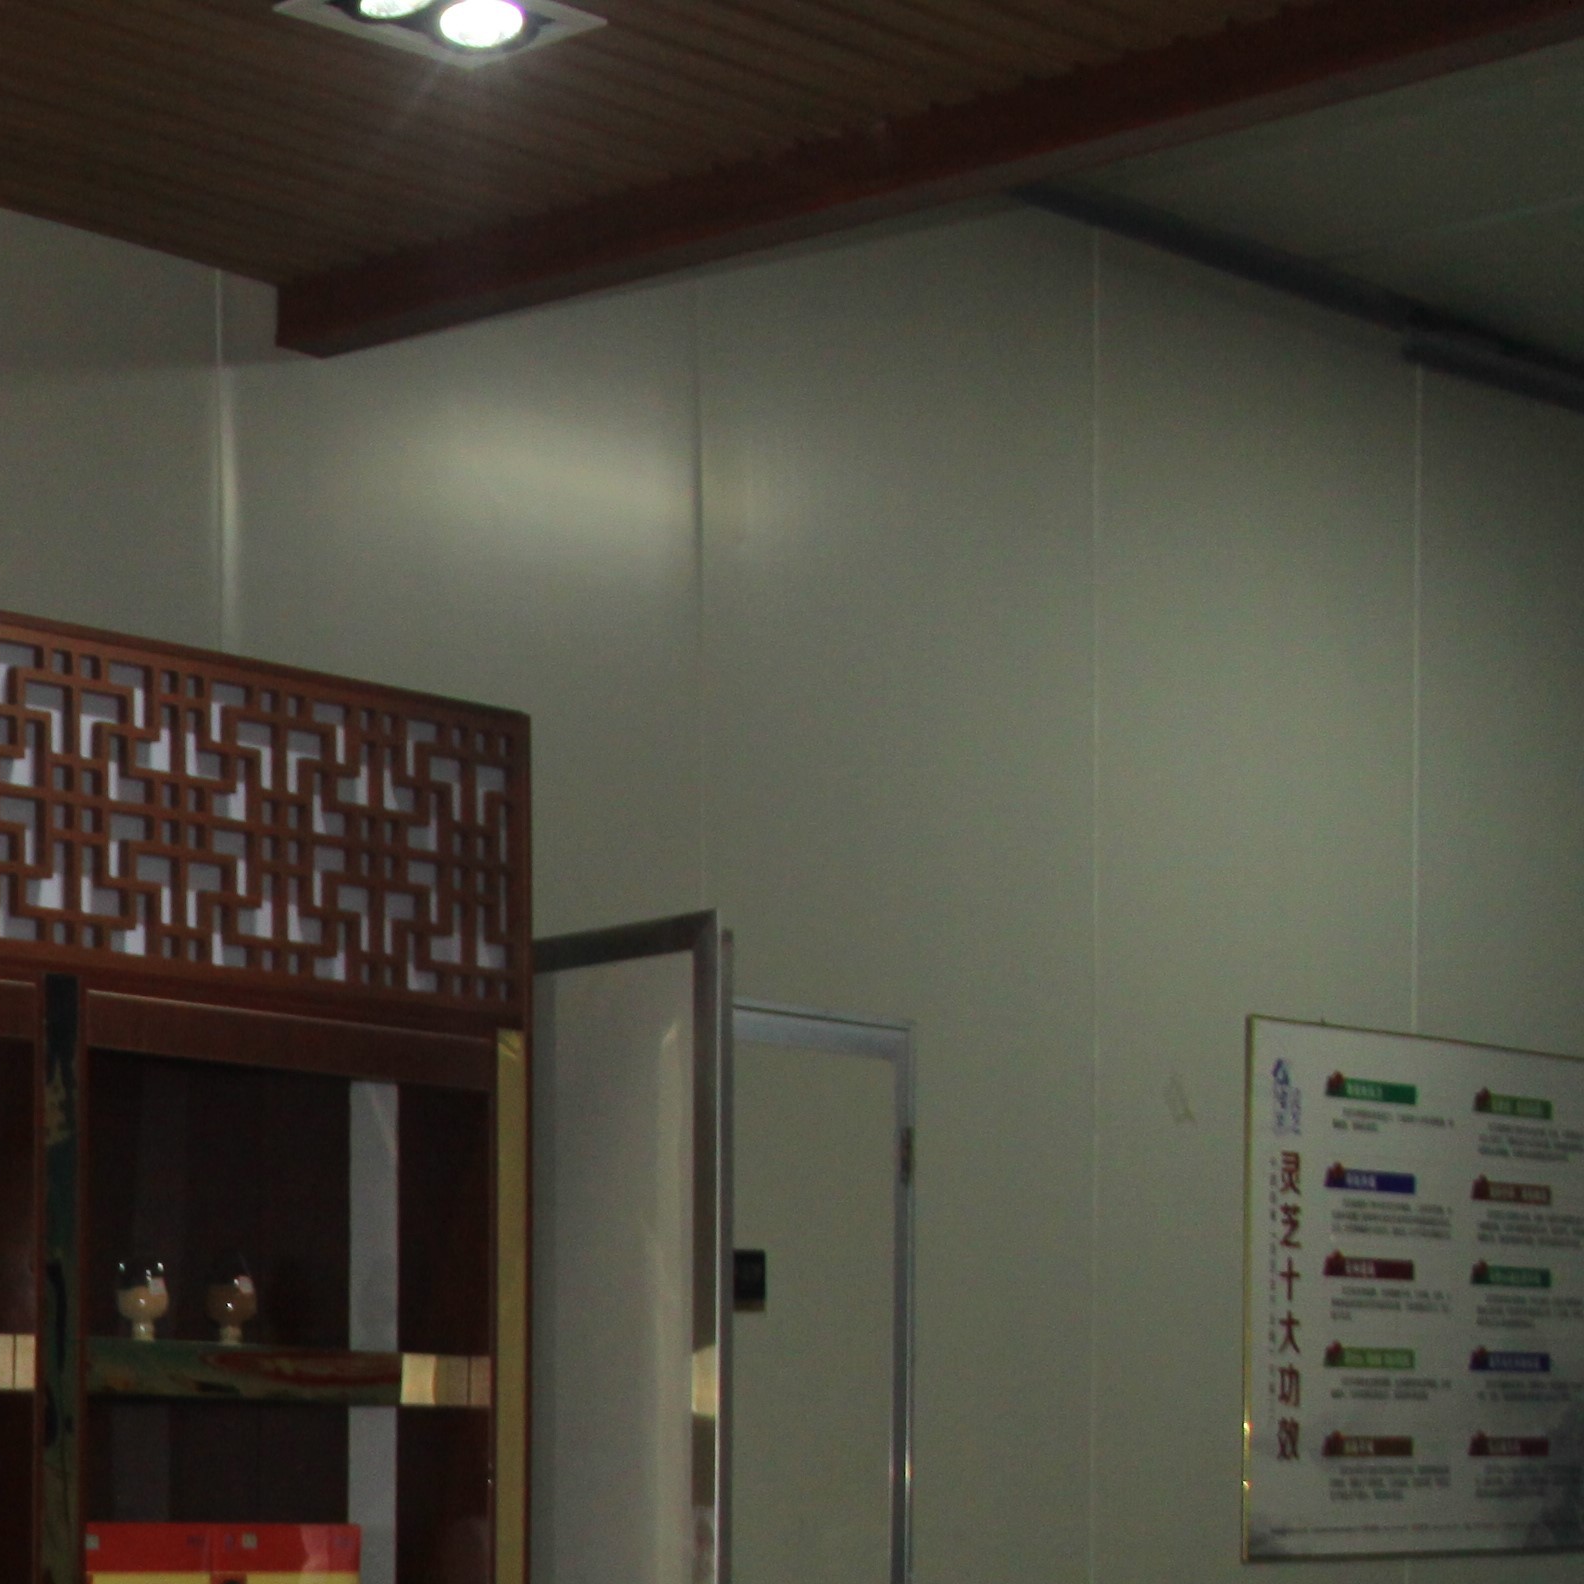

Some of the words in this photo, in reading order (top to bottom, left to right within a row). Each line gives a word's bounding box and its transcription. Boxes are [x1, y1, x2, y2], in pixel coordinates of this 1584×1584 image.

[1277, 1150, 1301, 1461] 灵芝十大功效
